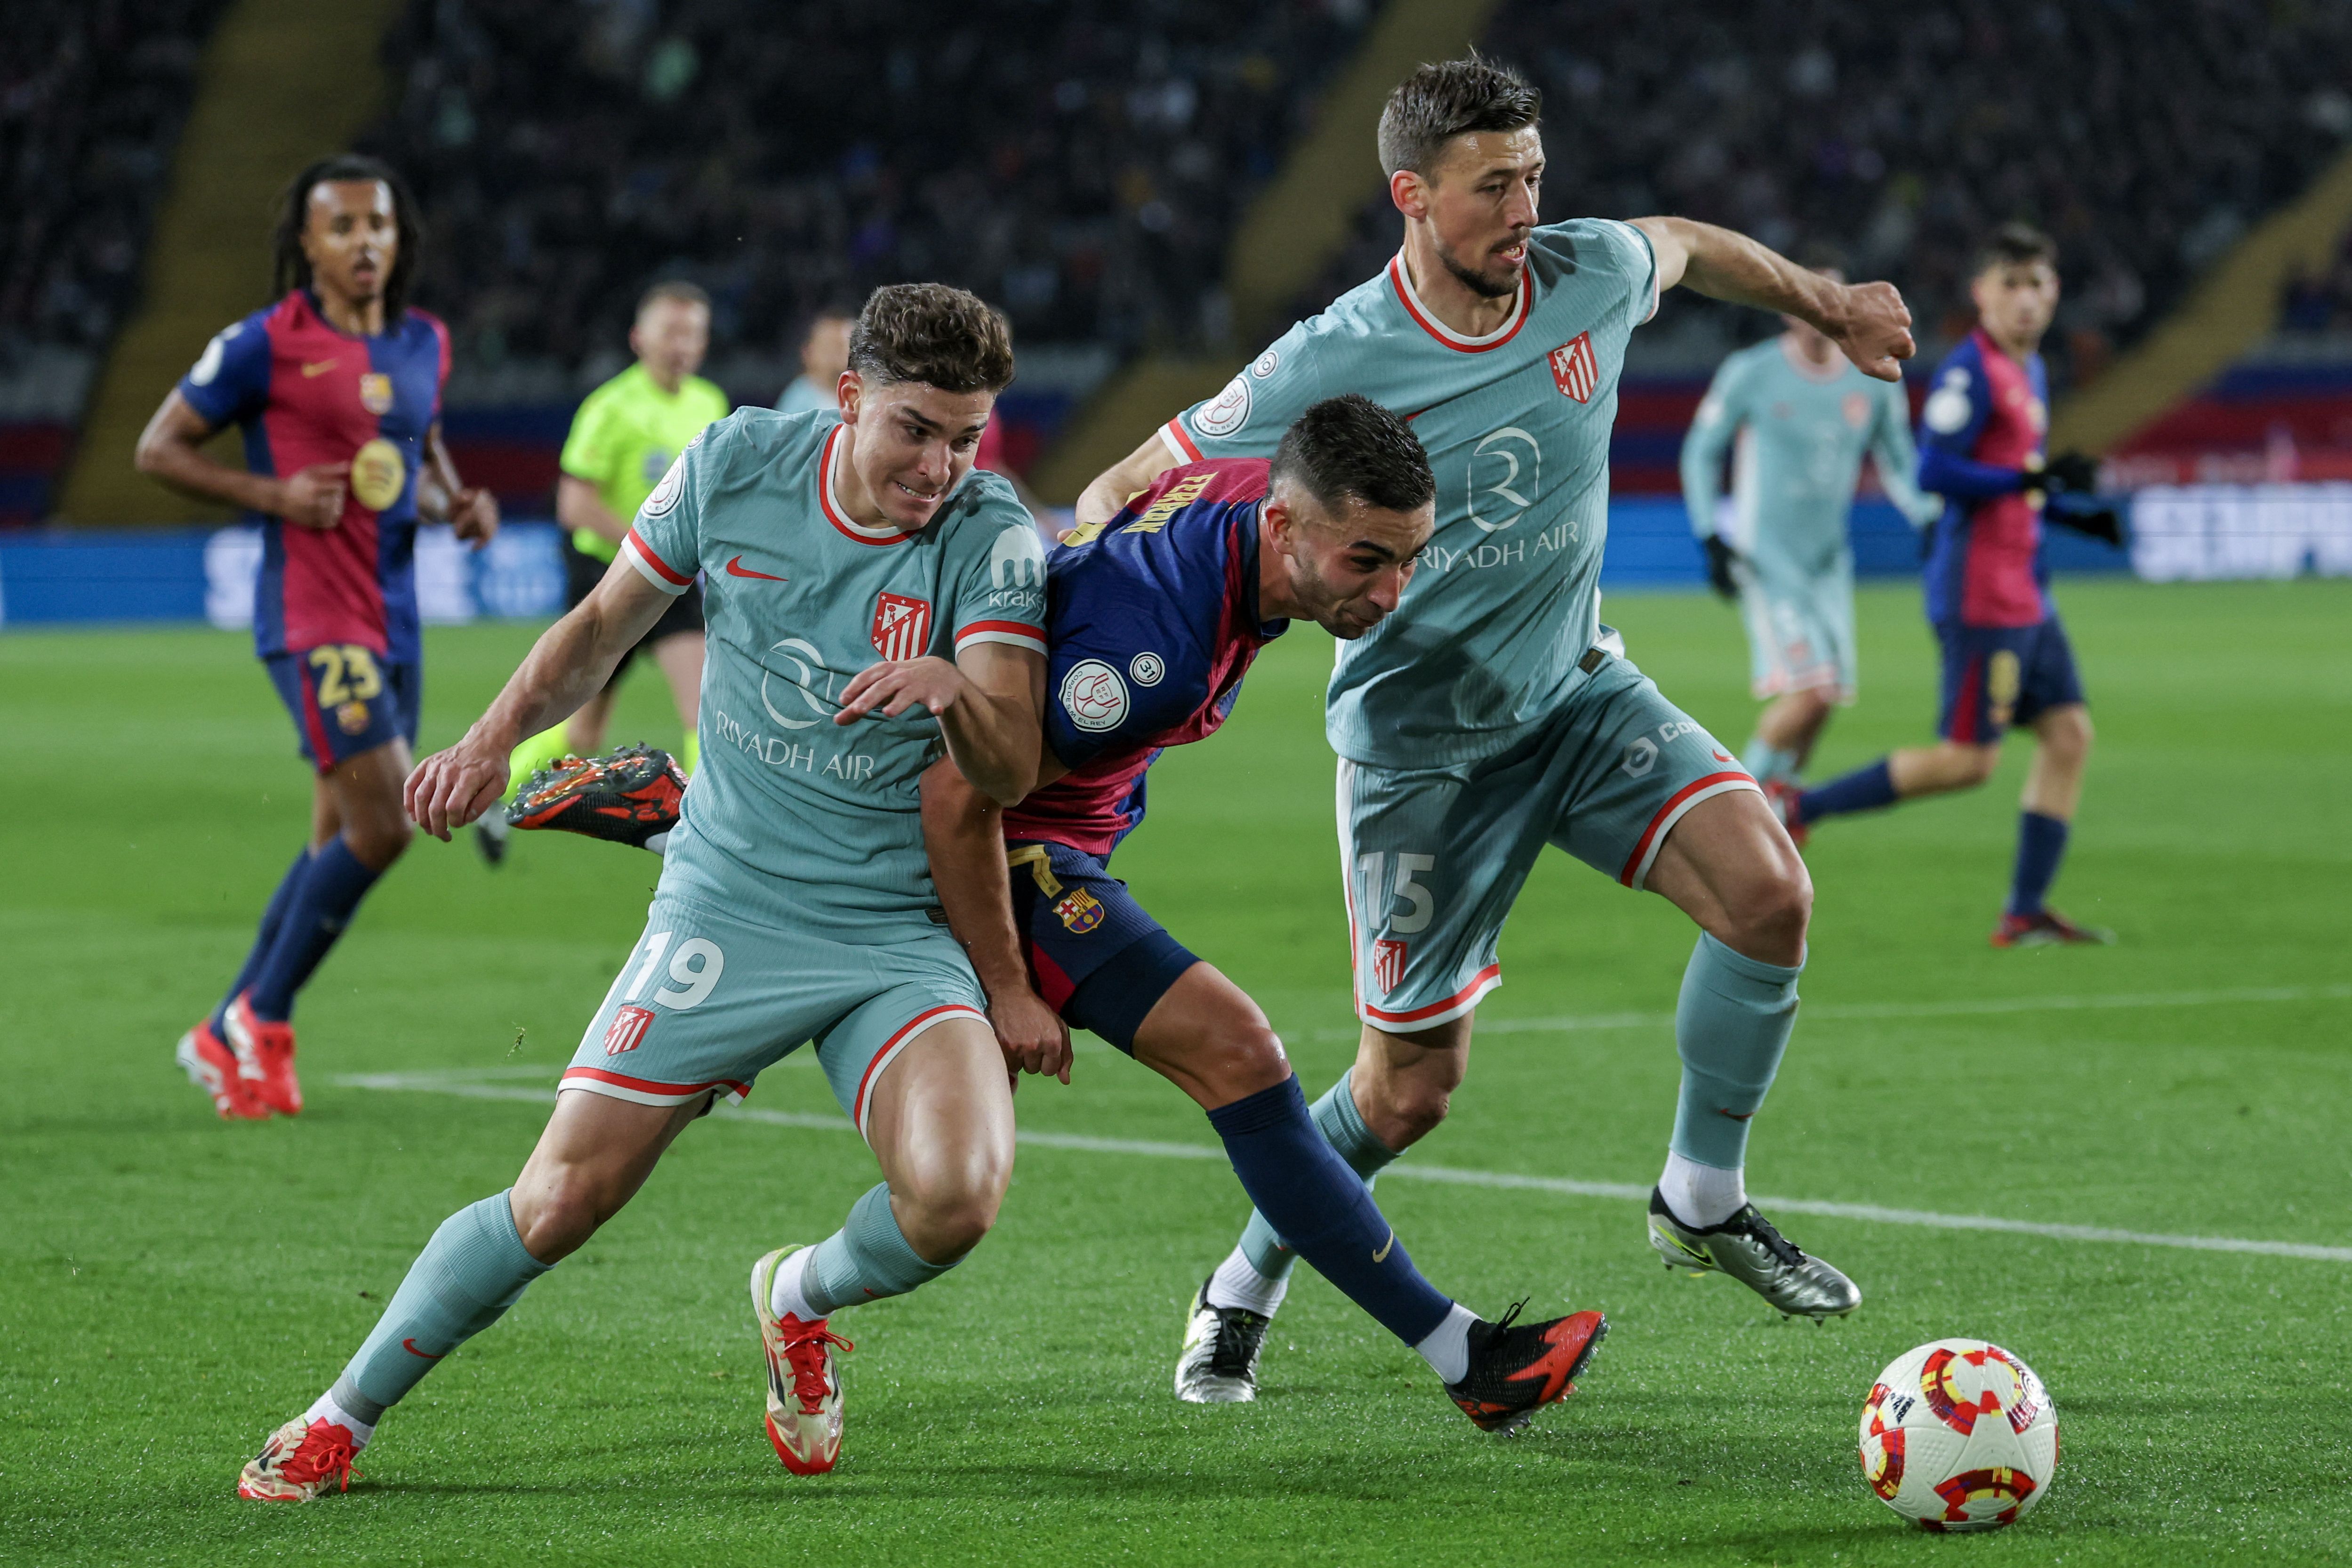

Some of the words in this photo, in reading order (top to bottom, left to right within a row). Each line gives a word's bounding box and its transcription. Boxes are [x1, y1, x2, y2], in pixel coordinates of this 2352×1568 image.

[1121, 472, 1219, 533] FERRAN
[1533, 521, 1578, 556] AIR
[988, 591, 1047, 611] krake
[309, 644, 383, 709] 23
[1067, 671, 1083, 690] COPA
[1140, 660, 1156, 678] 31
[1066, 691, 1072, 702] DE
[716, 710, 814, 772] RIYADH
[821, 754, 874, 780] AIR
[1358, 851, 1436, 934] 15
[623, 930, 725, 1011] 19
